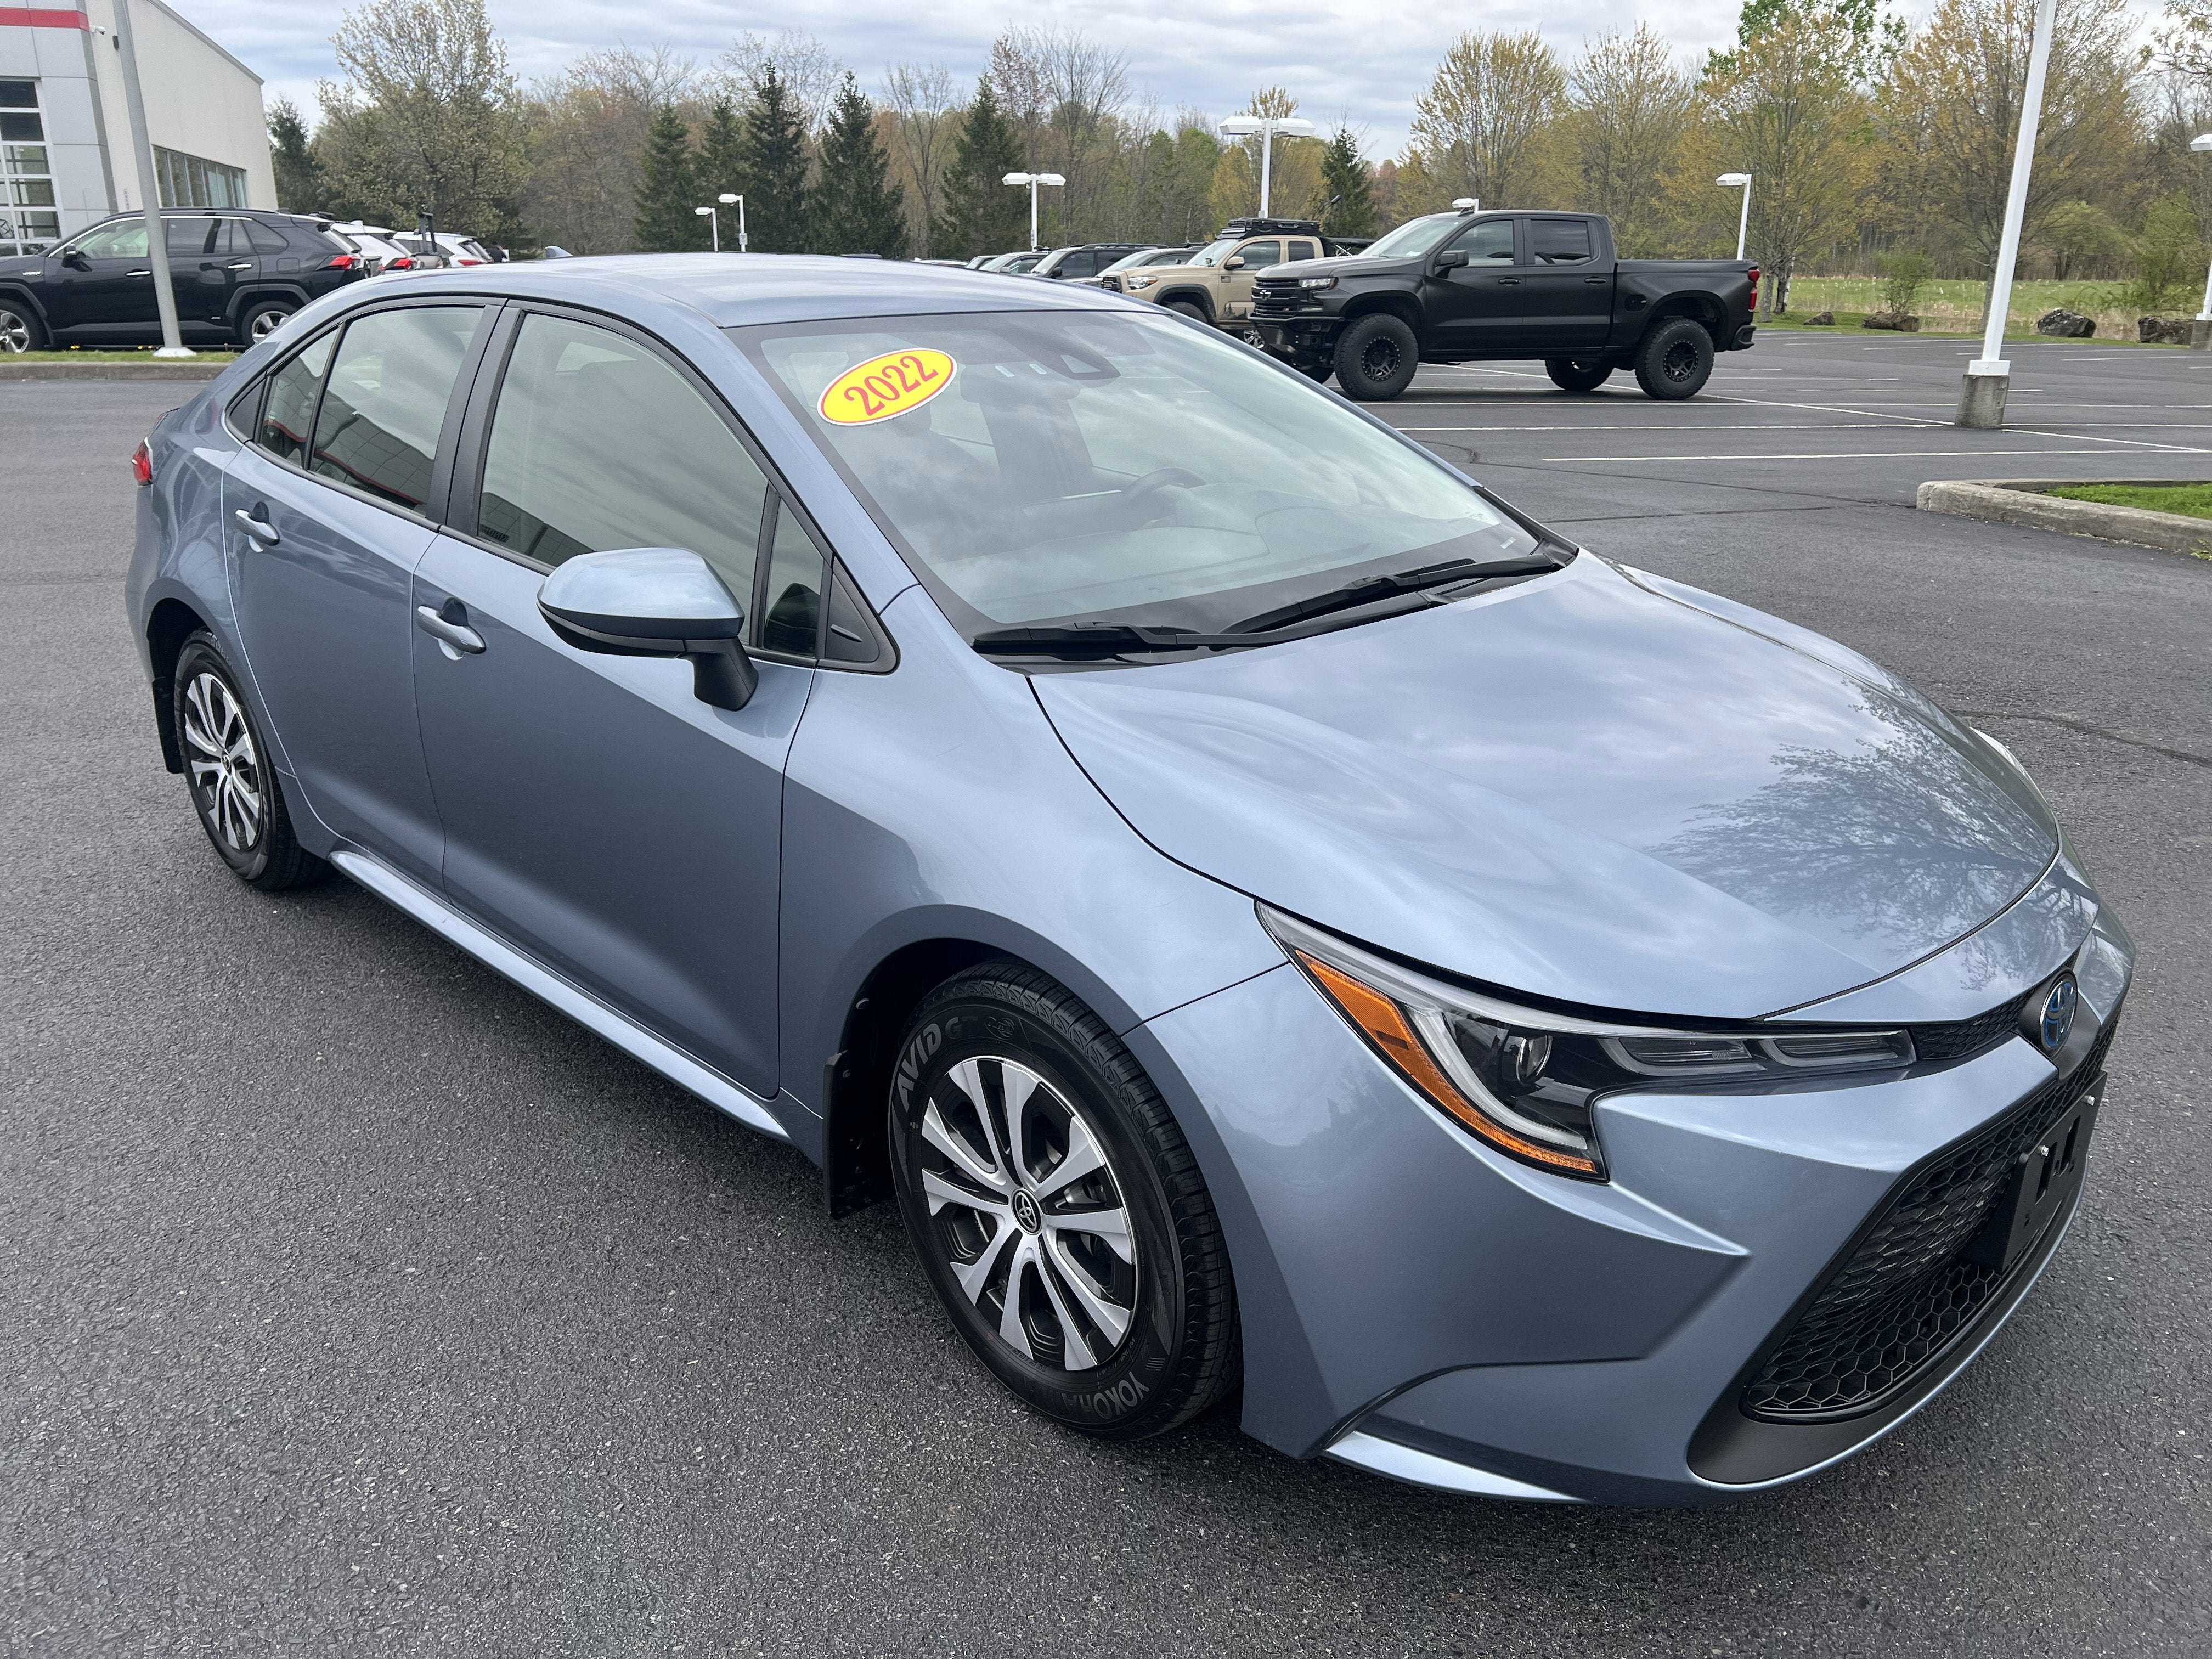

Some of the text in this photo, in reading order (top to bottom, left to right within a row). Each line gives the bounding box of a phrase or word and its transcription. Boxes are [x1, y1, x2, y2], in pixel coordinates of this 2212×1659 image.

[844, 356, 939, 416] 2022
[897, 1023, 942, 1113] AVID
[1056, 1371, 1150, 1420] YOKOHA
